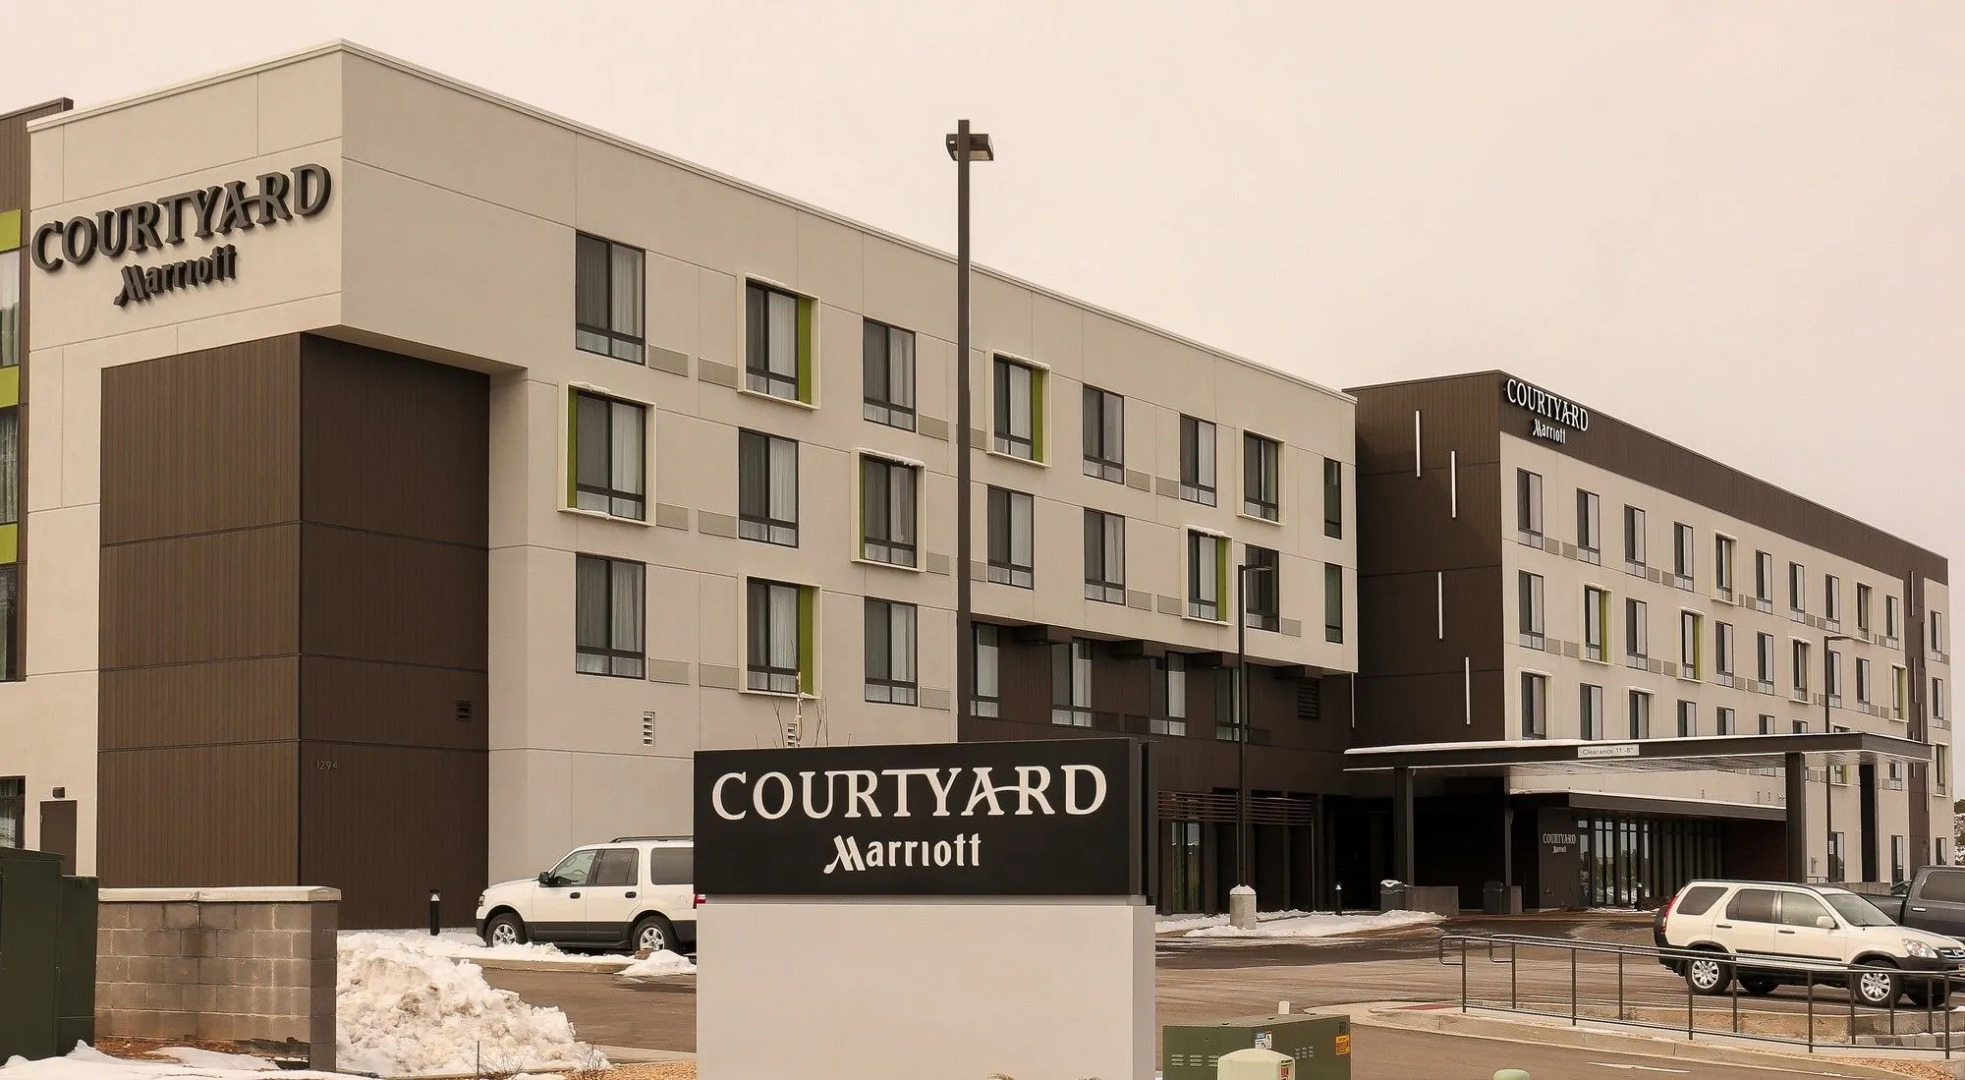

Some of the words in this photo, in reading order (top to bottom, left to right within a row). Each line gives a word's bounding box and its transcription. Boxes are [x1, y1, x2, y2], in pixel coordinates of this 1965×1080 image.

[31, 163, 332, 272] COURTYARD
[113, 243, 238, 307] Marriott
[1507, 378, 1589, 432] COURTYARD
[1532, 418, 1566, 444] Marriott
[316, 760, 338, 770] 1294
[1582, 748, 1614, 756] Clearance
[711, 764, 1107, 820] COURTYARD
[823, 832, 982, 875] Marriott
